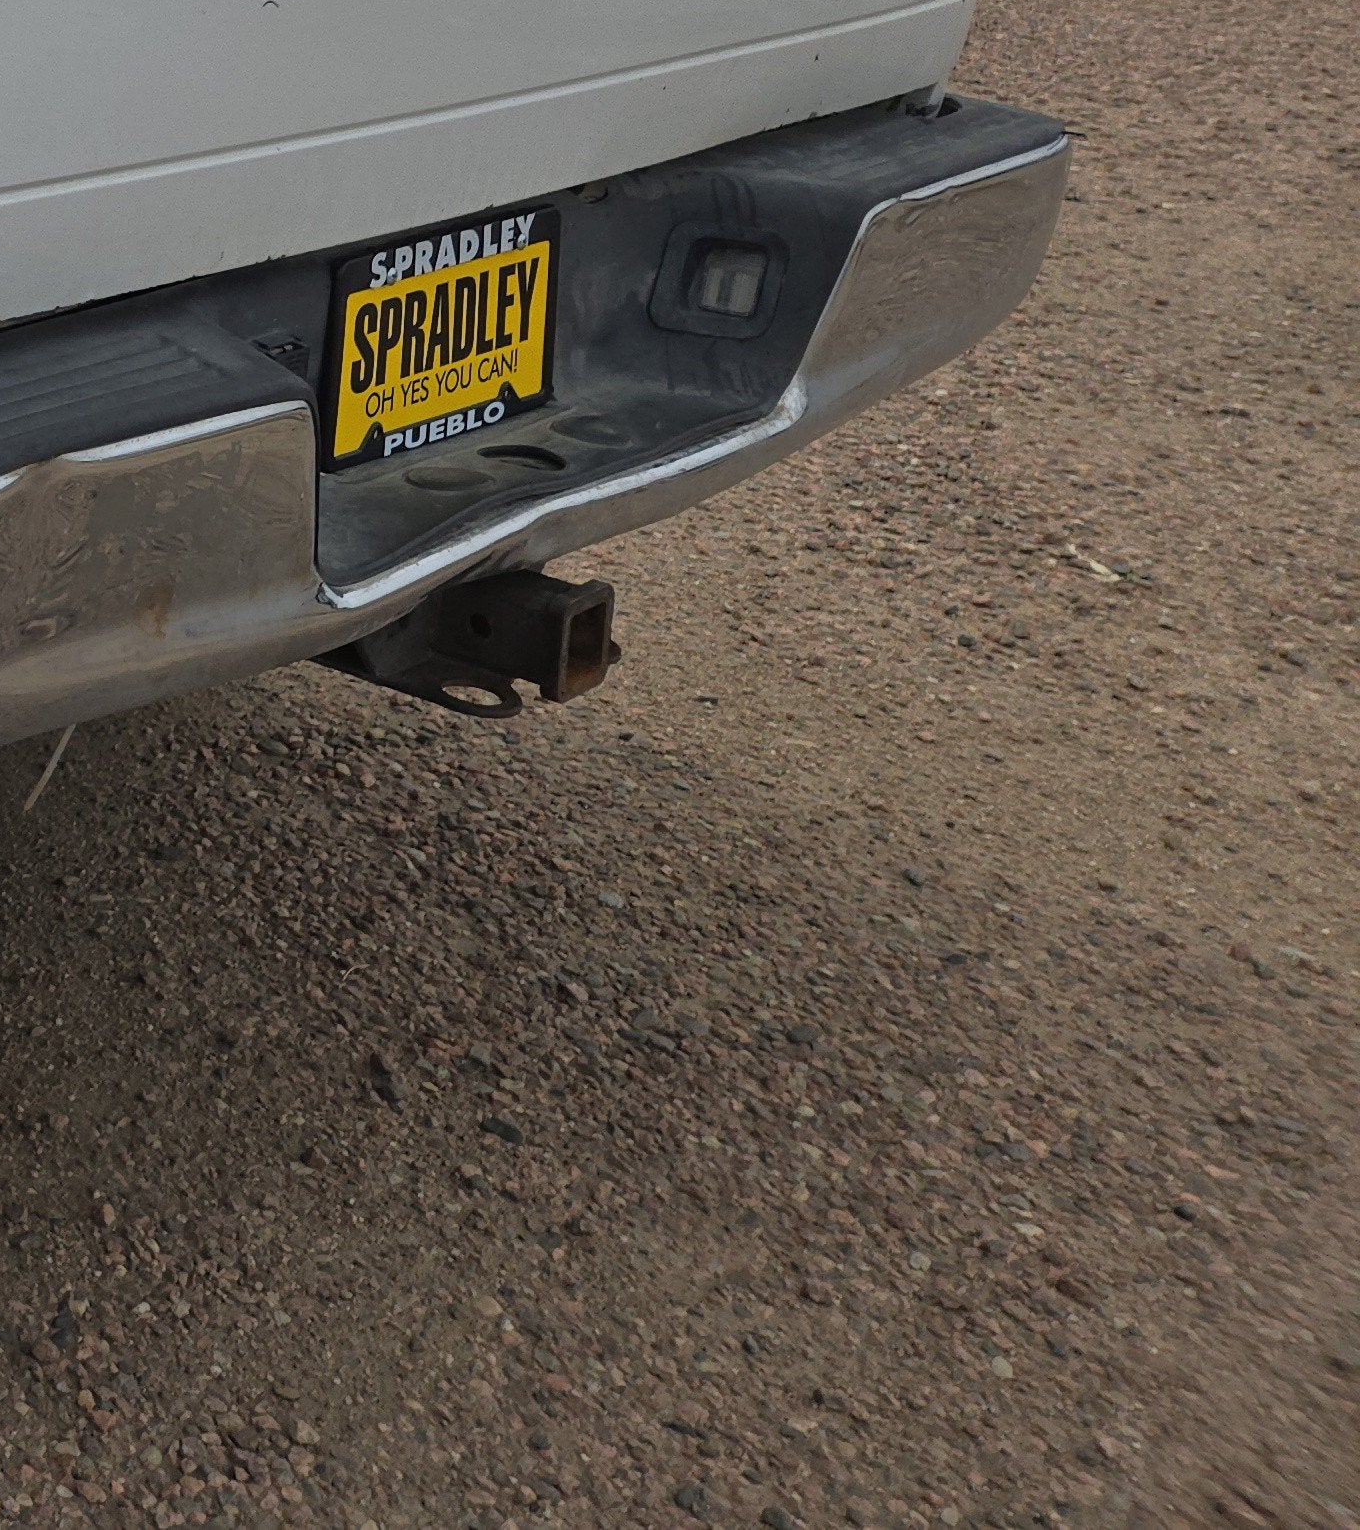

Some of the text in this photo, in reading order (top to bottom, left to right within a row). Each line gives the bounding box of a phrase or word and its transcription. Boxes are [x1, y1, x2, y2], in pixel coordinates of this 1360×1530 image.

[369, 212, 537, 289] SPRADLEY
[350, 256, 541, 395] SPRADLEY
[365, 347, 519, 419] OH YES YOU CAN!
[383, 401, 507, 458] PUEBLO
